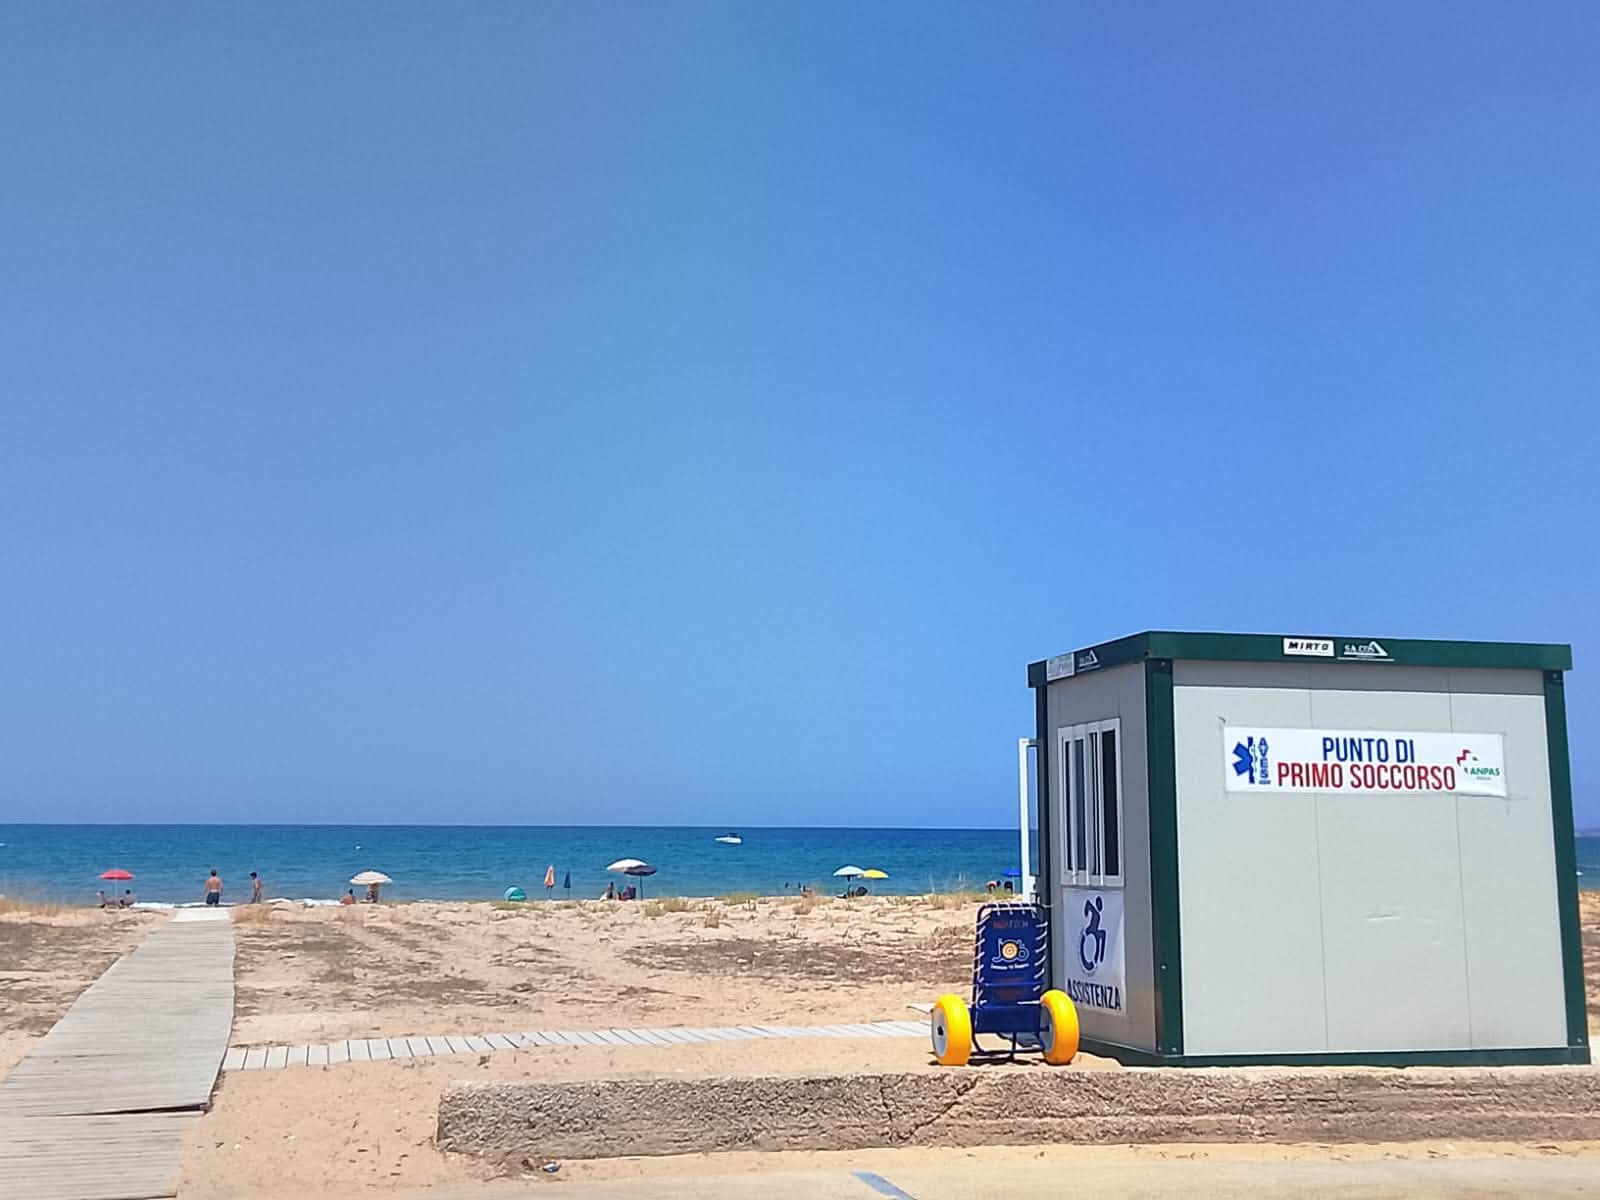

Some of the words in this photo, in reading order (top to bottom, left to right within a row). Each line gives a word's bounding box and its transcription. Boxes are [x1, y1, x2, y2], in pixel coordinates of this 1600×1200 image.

[1287, 641, 1329, 651] MIRTO
[1322, 737, 1390, 763] PUNTO
[1396, 739, 1415, 763] DI
[1277, 761, 1344, 788] PRIMO
[1350, 764, 1456, 791] SOCCORSO
[1470, 767, 1500, 776] ANPAS
[1067, 978, 1121, 1011] ASSISTENZA
